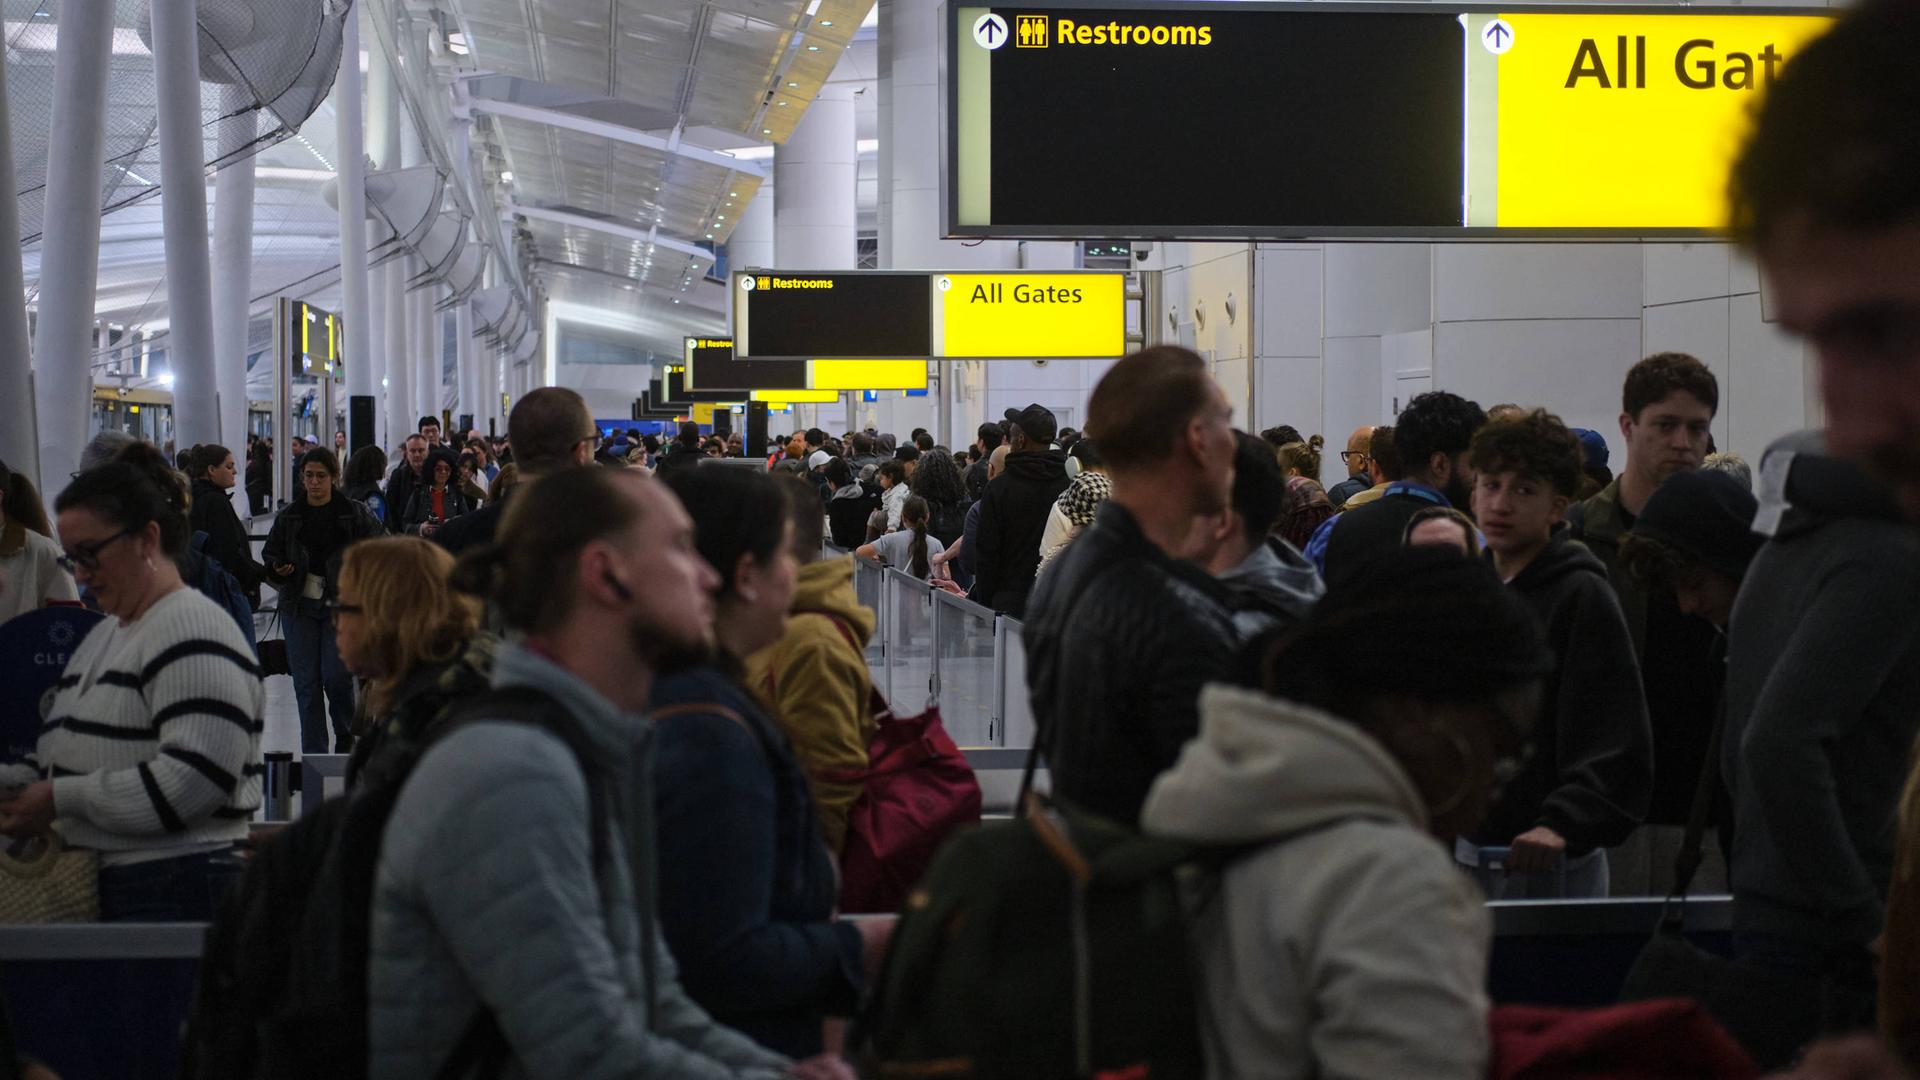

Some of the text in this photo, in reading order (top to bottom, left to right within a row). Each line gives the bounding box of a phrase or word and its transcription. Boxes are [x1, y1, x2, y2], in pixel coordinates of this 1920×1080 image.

[1057, 19, 1212, 46] Restrooms
[1564, 36, 1783, 90] All Gat
[772, 277, 834, 289] Restrooms
[970, 282, 1083, 305] All Gates
[707, 339, 733, 348] Restro
[34, 652, 66, 665] CLE
